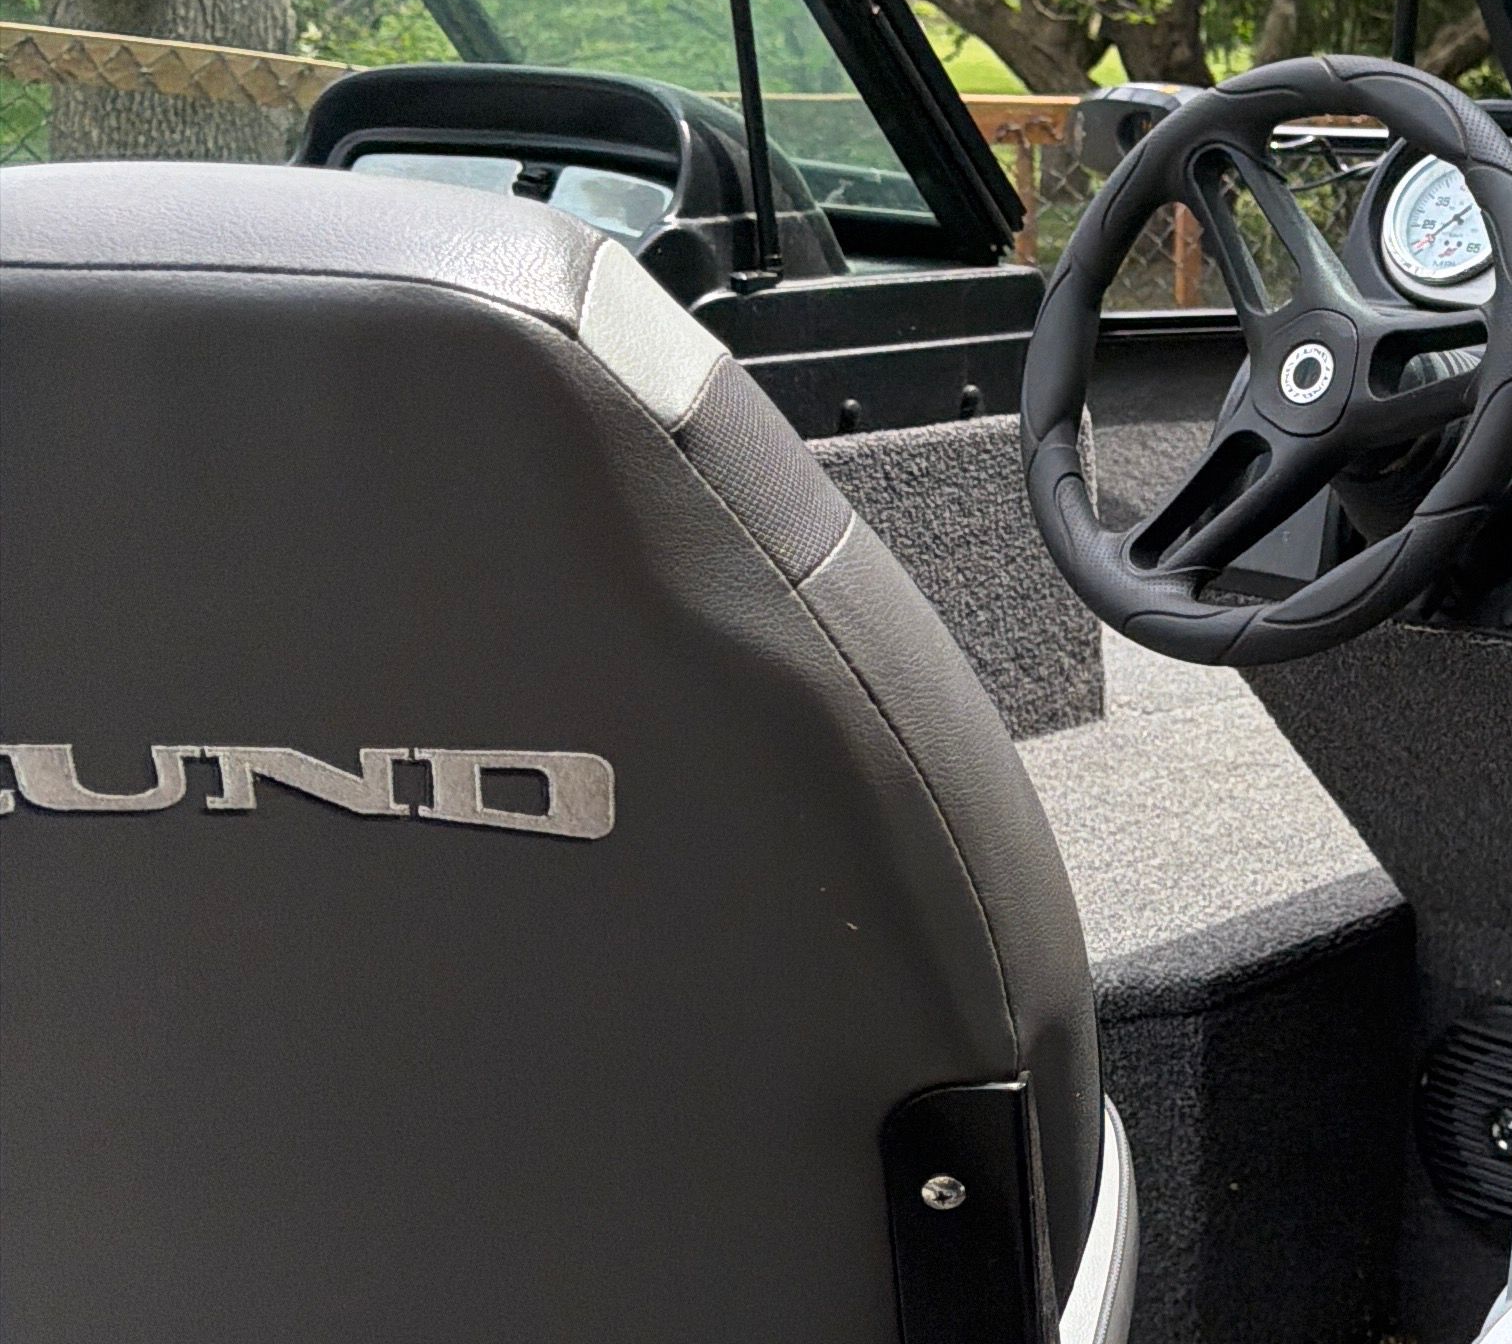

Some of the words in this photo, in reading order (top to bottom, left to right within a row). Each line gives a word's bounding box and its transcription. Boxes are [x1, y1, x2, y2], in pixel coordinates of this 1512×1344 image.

[1435, 196, 1450, 207] 35
[1421, 219, 1437, 230] 25
[1466, 242, 1481, 253] 65
[0, 744, 616, 839] UND
